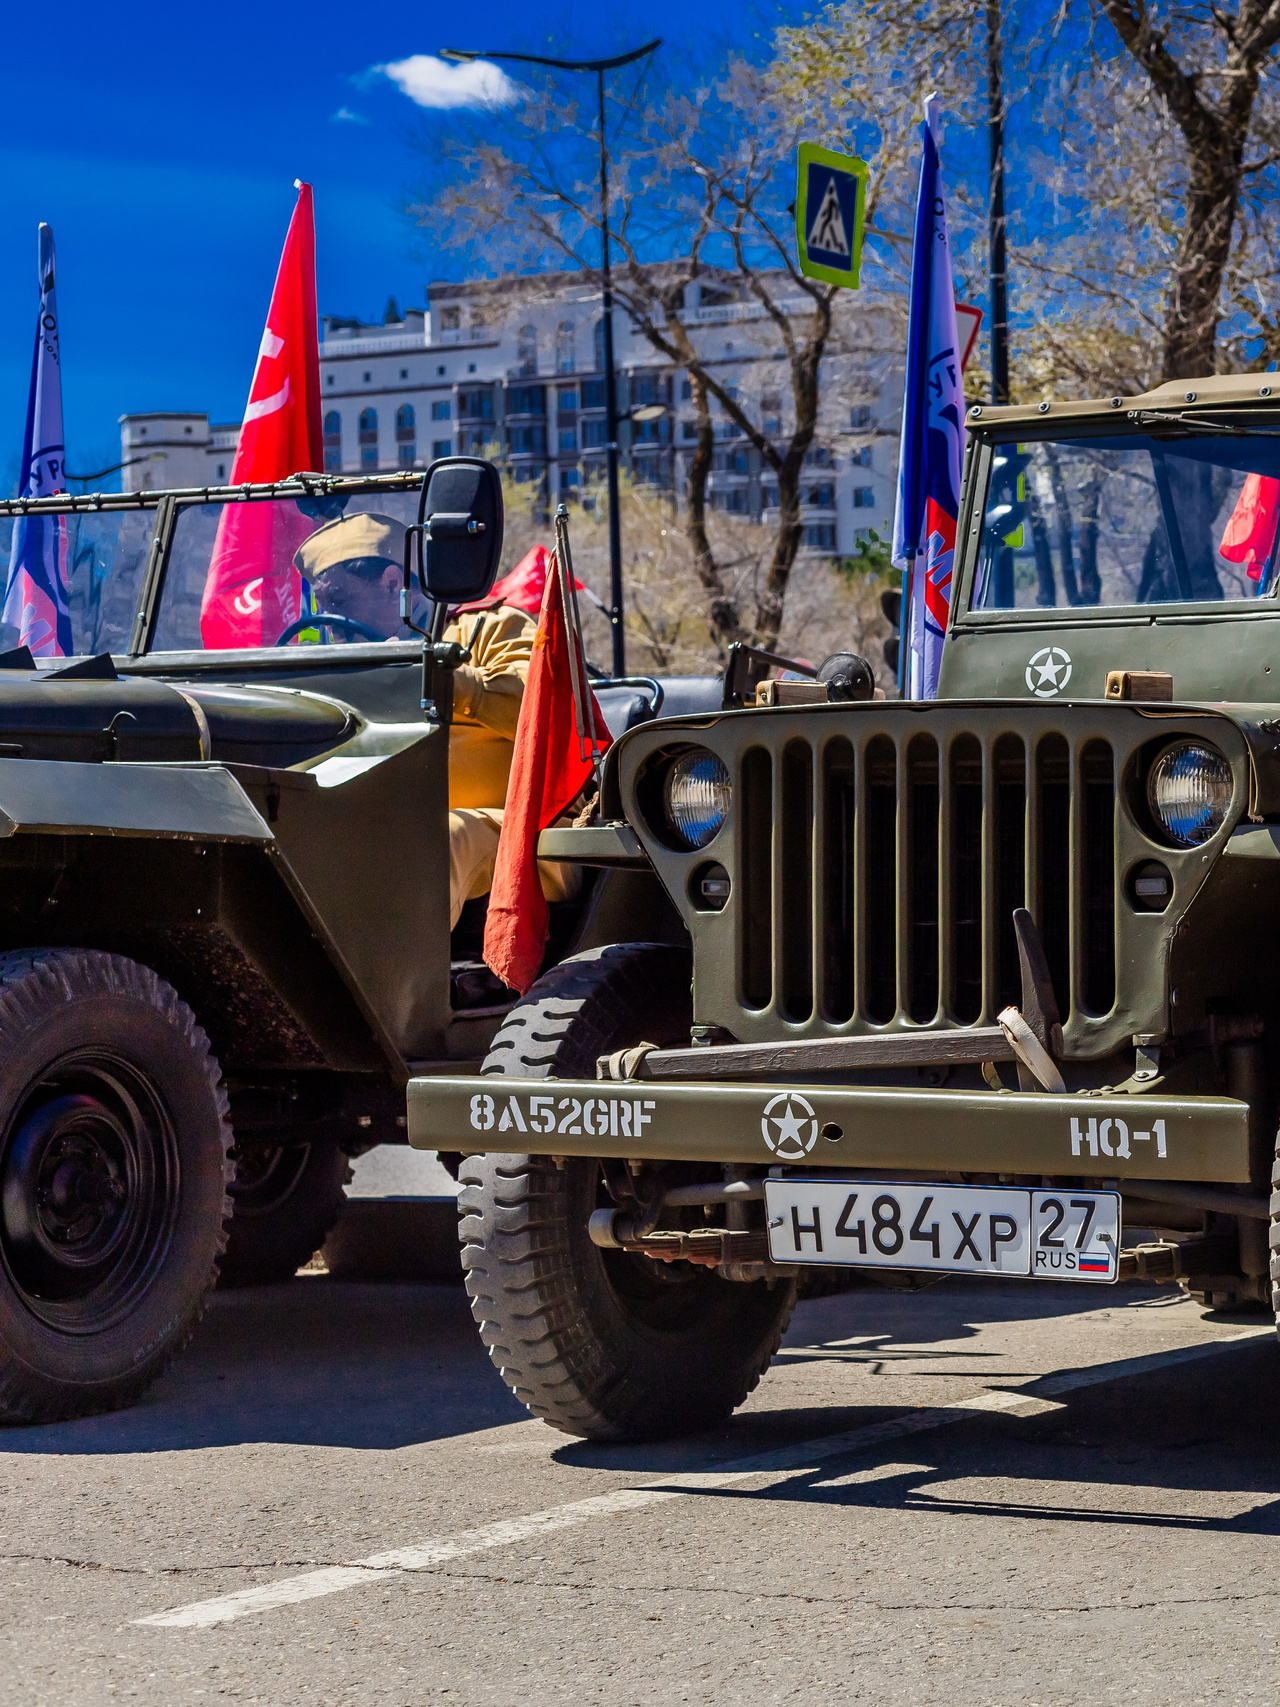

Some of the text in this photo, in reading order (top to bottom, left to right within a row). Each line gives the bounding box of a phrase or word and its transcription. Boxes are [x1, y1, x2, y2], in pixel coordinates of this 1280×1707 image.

[470, 1094, 654, 1137] 8A52GRF
[1070, 1117, 1167, 1158] HQ-1
[1038, 1198, 1094, 1250] 27
[1035, 1251, 1077, 1271] RUS
